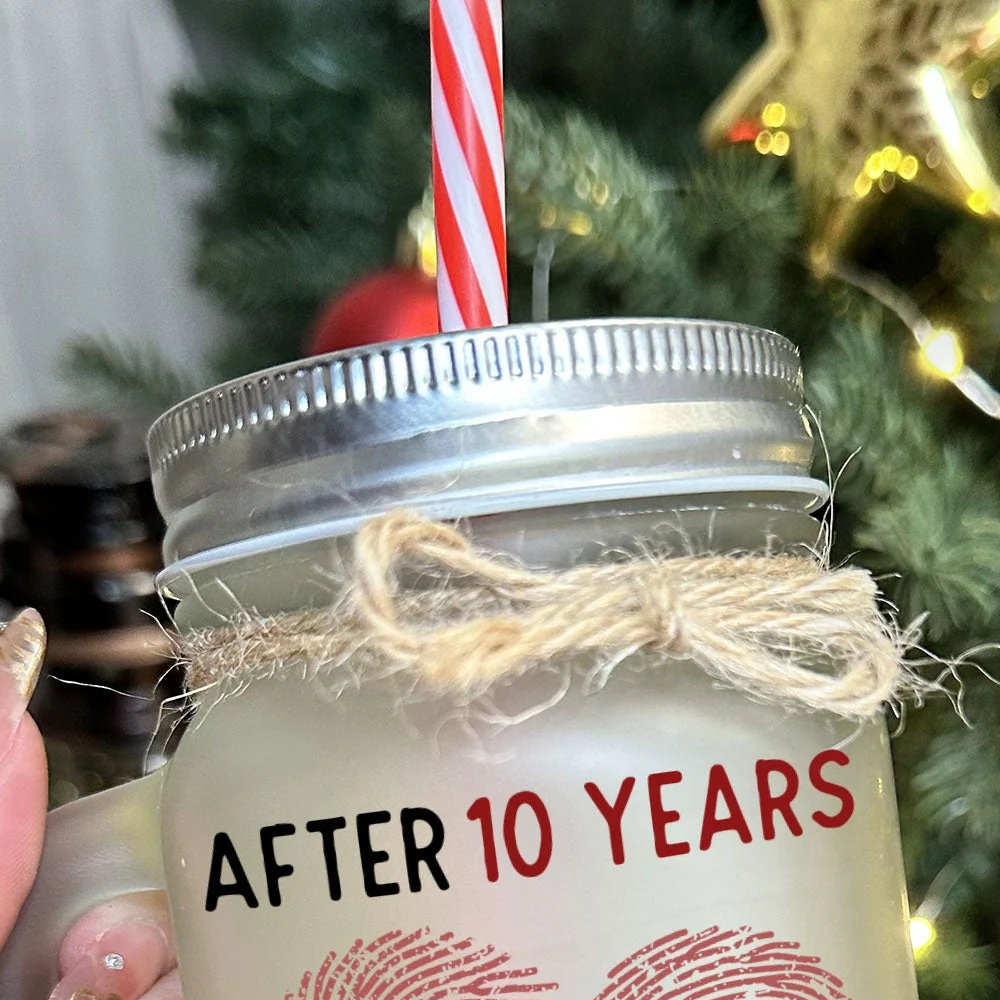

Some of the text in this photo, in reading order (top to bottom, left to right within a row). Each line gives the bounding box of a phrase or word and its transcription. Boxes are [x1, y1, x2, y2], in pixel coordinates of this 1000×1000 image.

[205, 749, 855, 912] AFTER 10 YEARS
